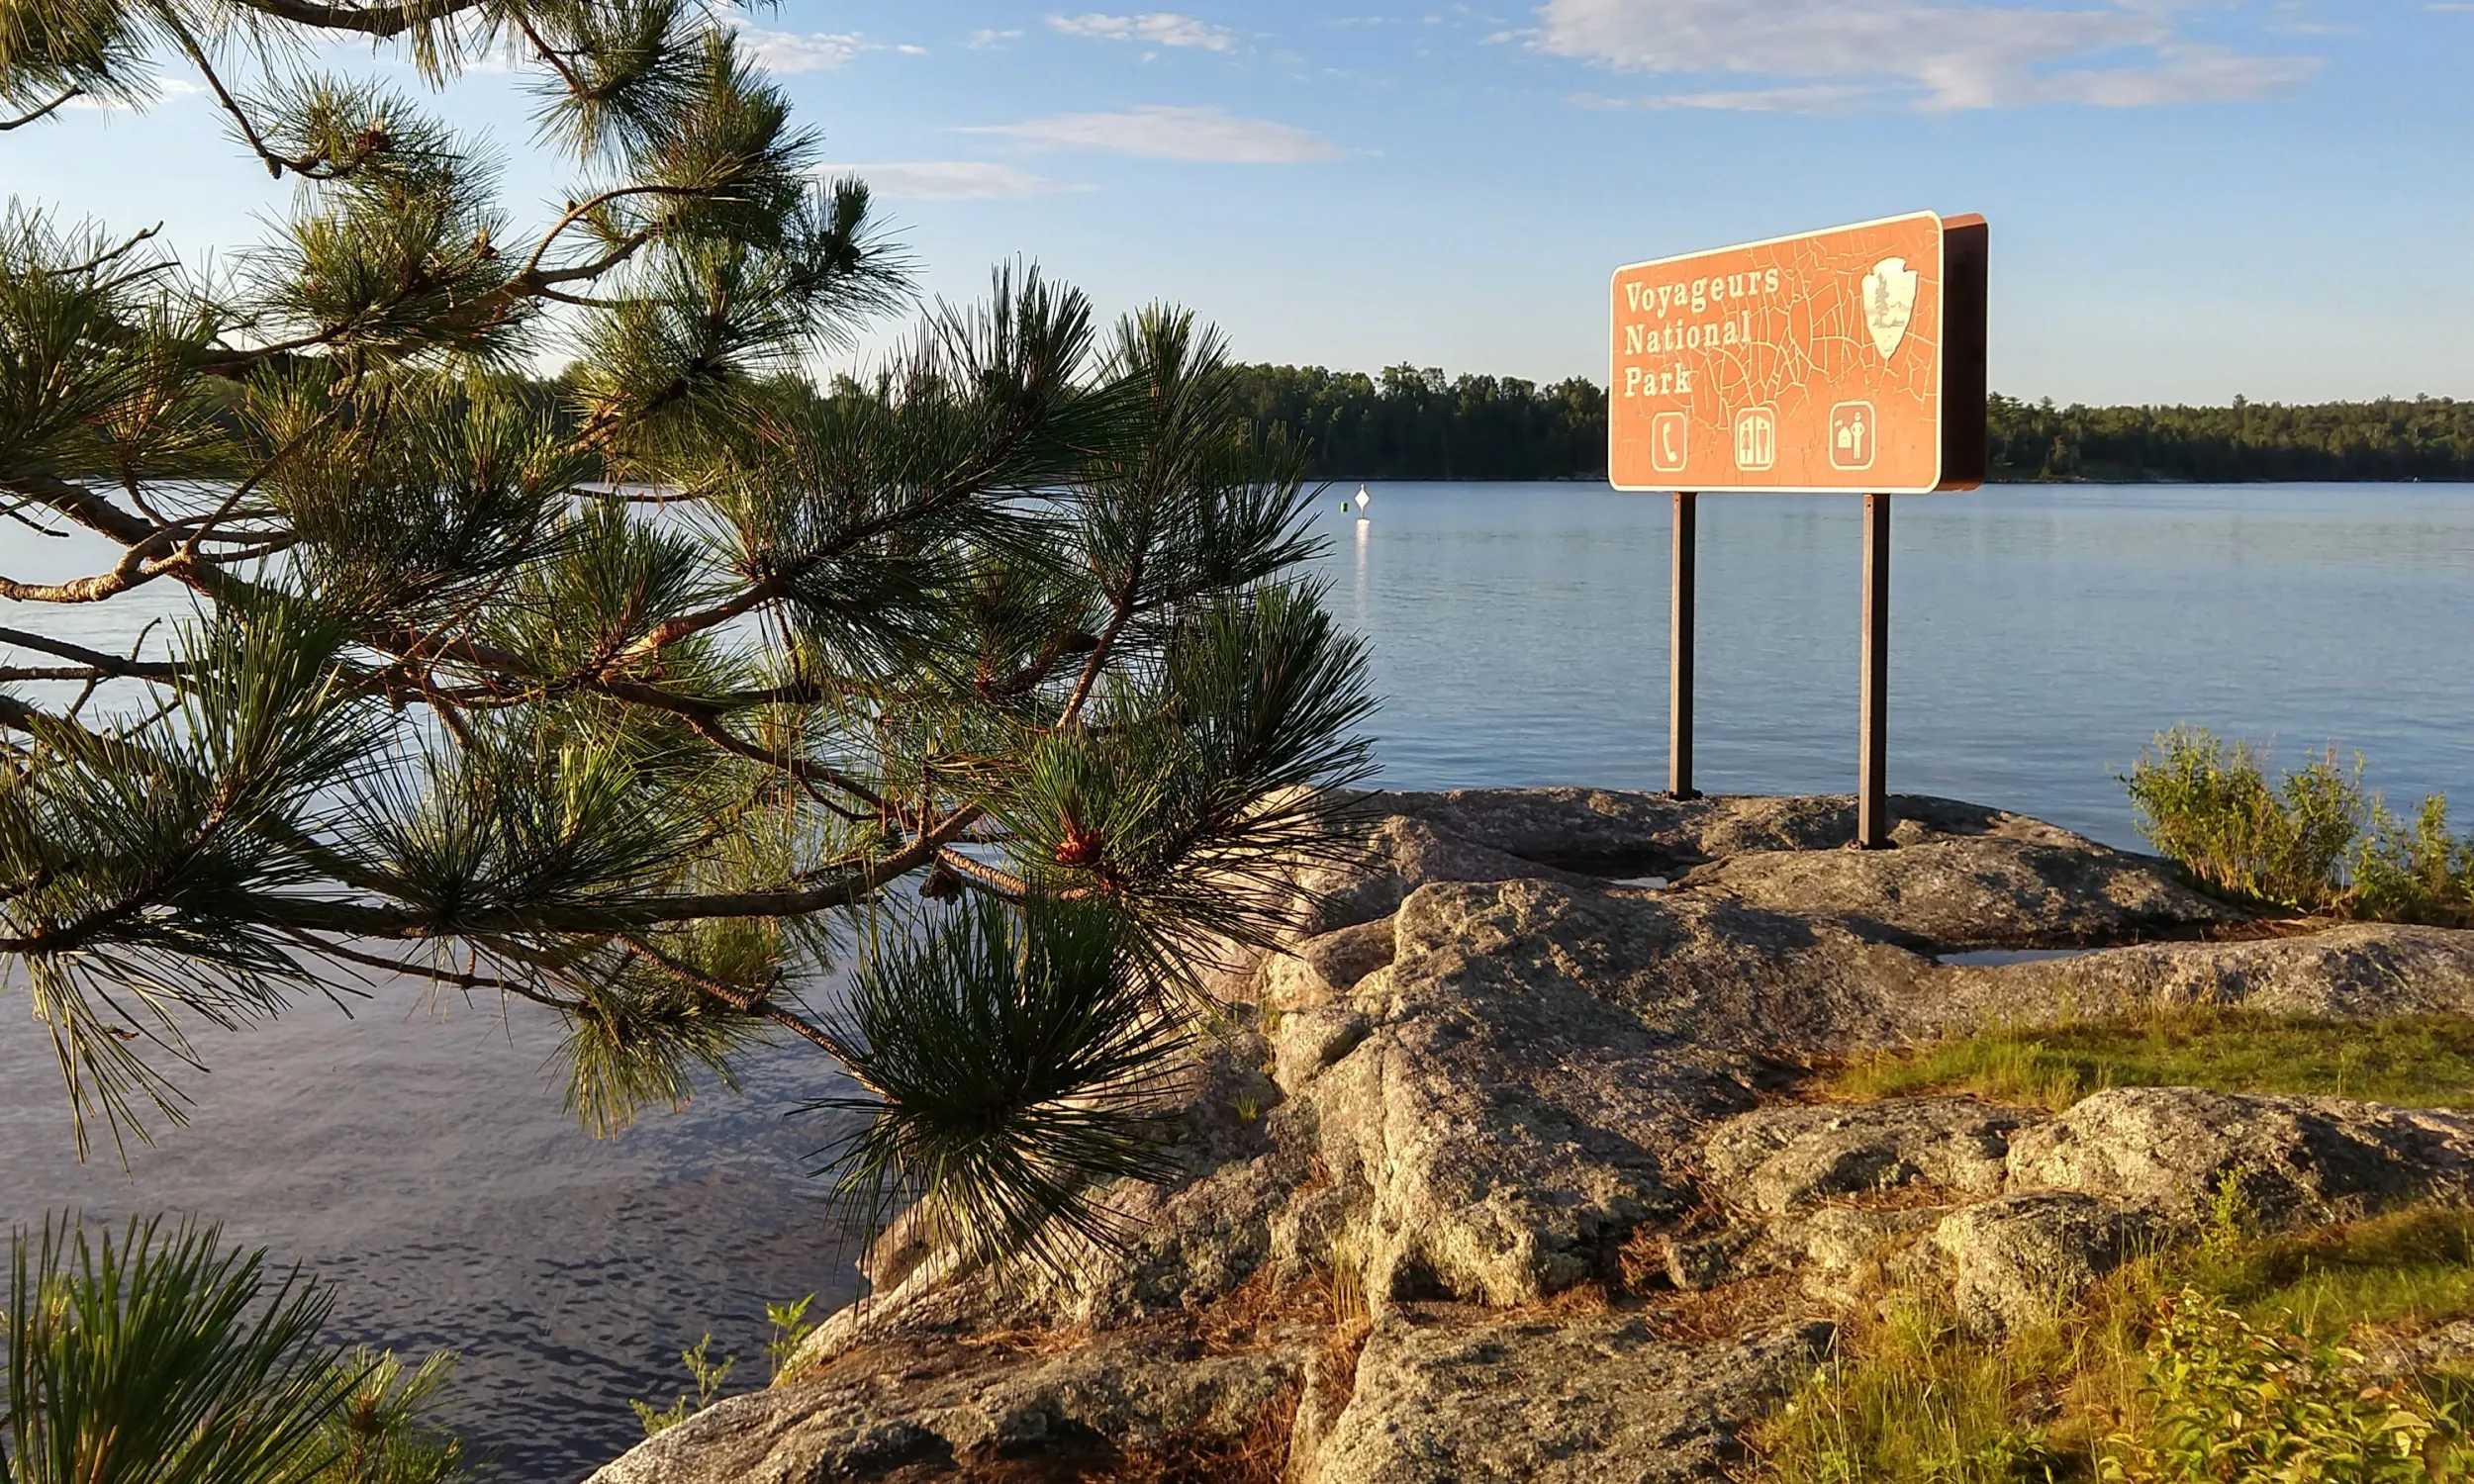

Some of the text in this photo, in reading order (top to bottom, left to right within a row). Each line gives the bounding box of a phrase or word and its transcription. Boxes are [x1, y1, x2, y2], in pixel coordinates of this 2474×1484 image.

[1625, 268, 1779, 319] Voyageurs
[1625, 310, 1752, 355] National
[1625, 363, 1692, 397] Park
